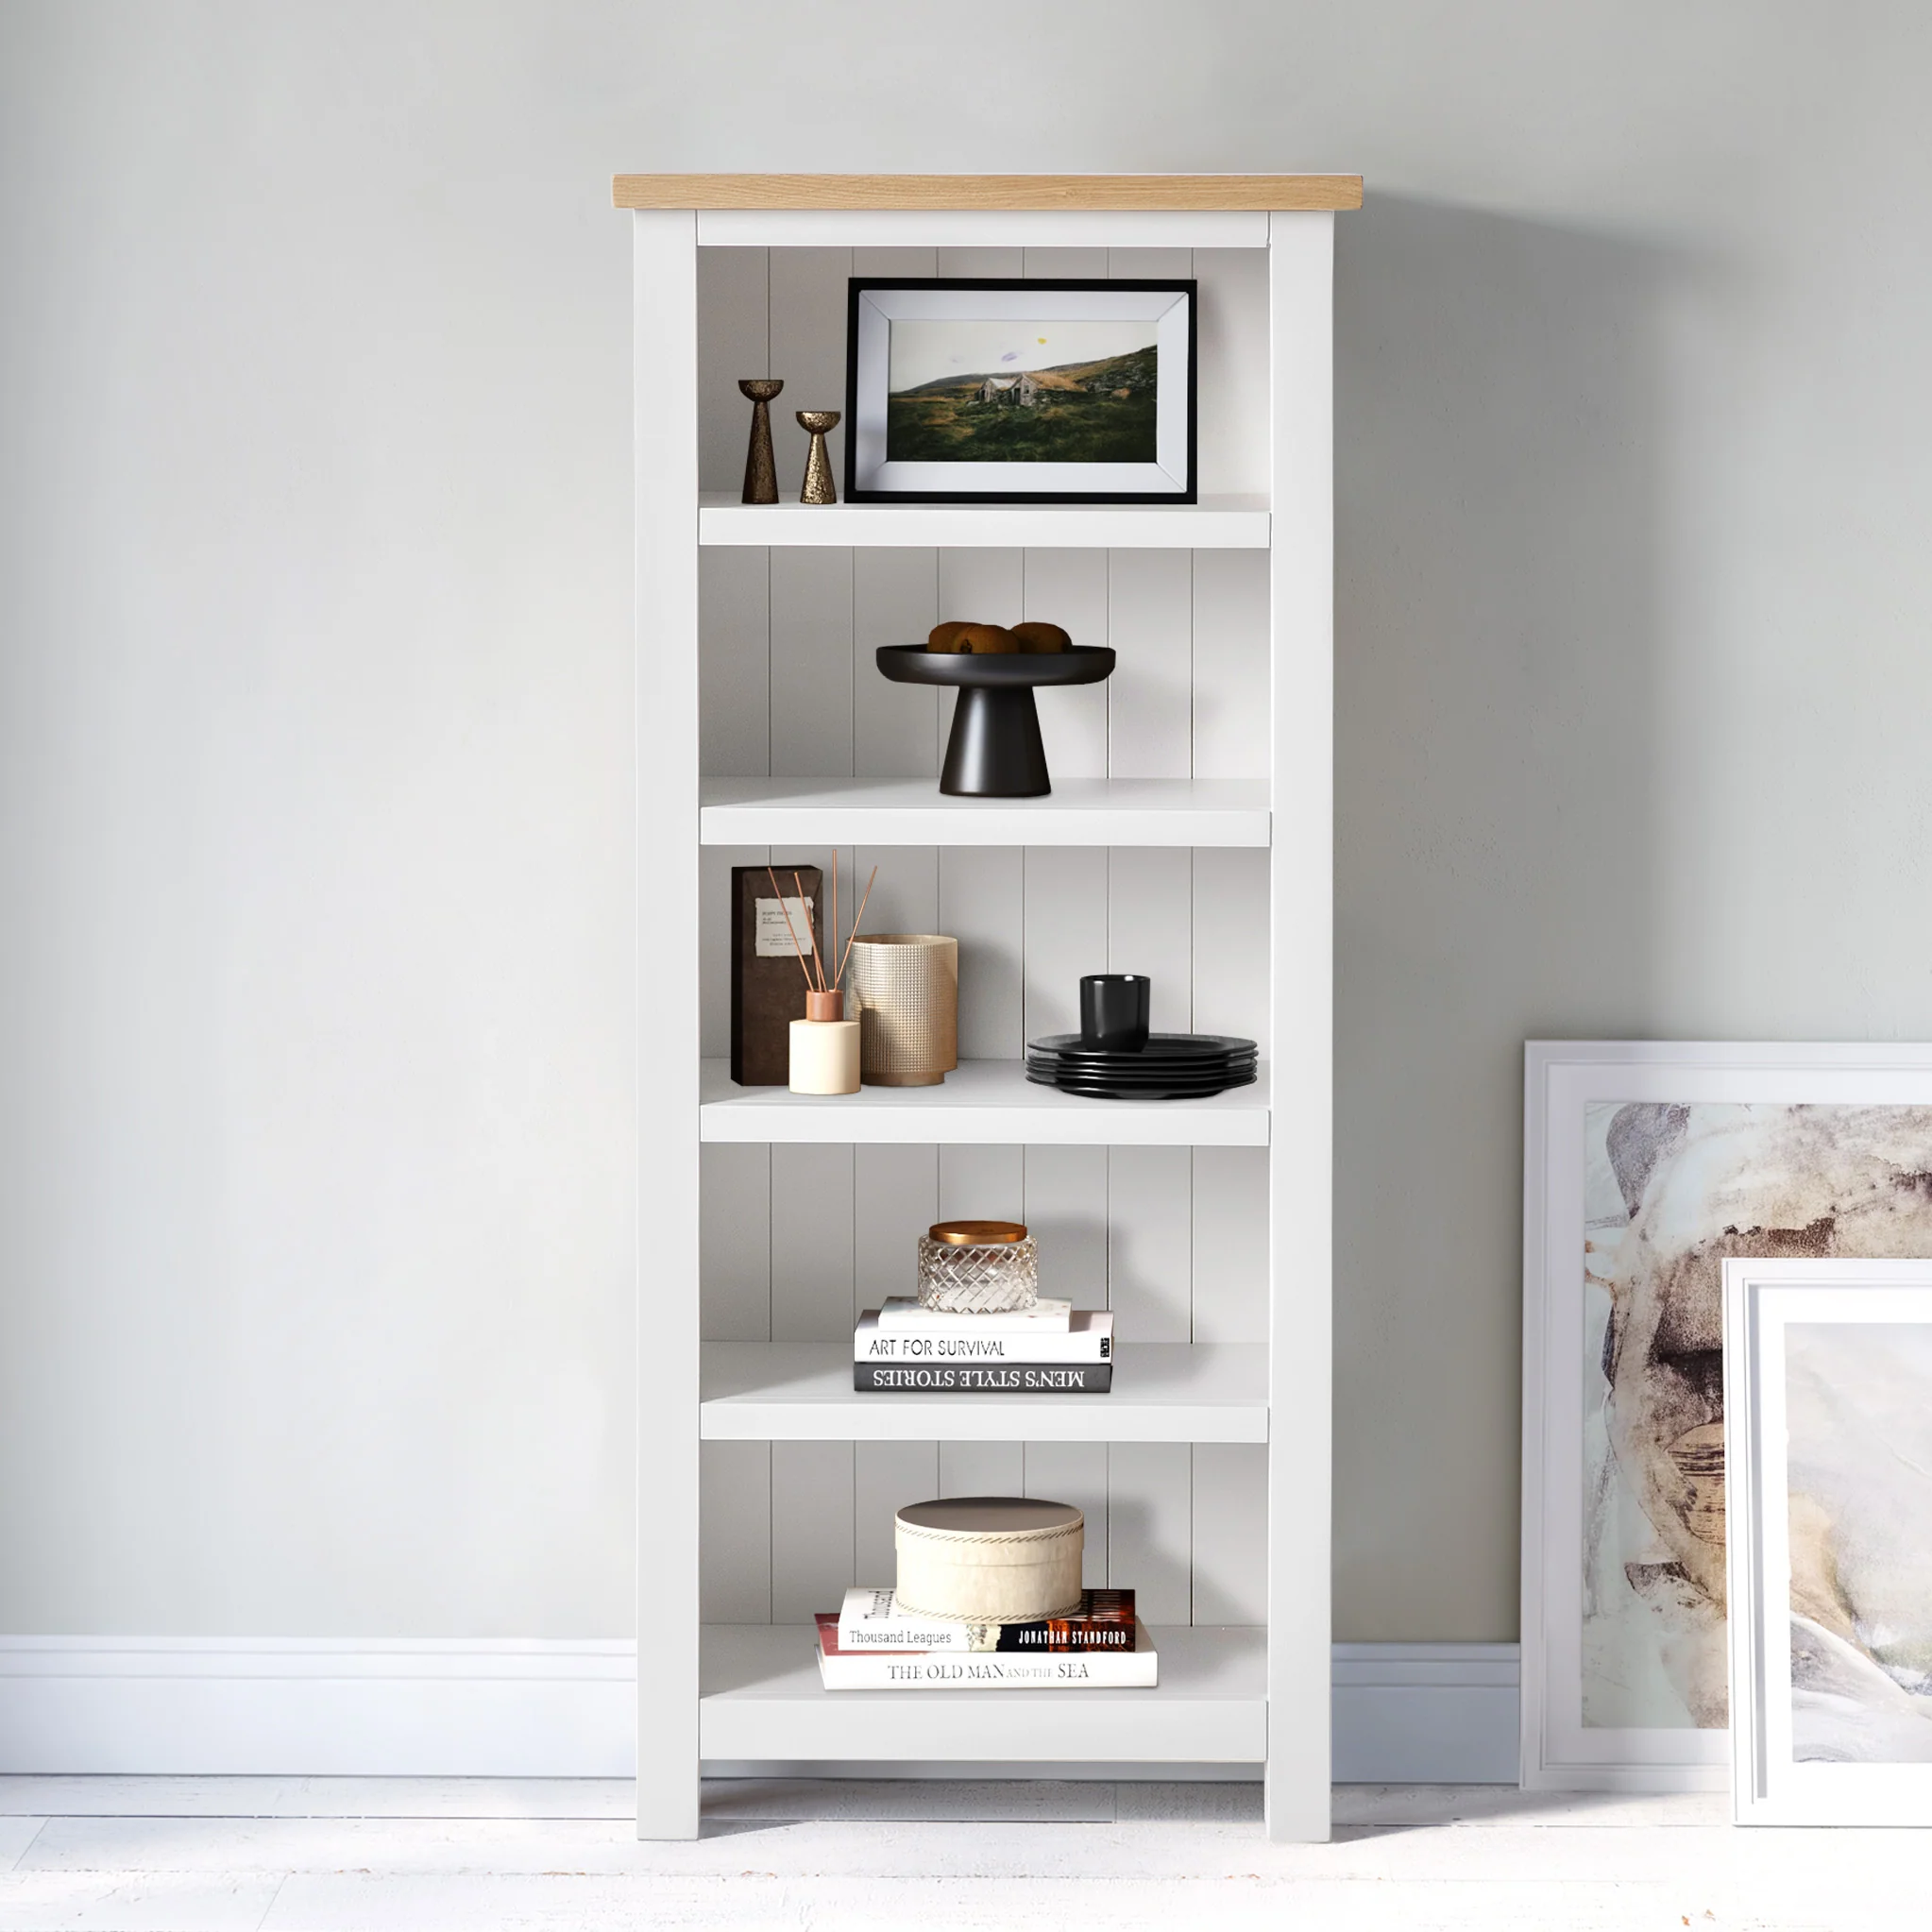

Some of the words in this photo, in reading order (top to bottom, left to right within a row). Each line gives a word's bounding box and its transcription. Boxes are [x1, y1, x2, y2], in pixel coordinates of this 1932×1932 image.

[869, 1339, 897, 1356] ART
[903, 1339, 933, 1356] FOR
[938, 1340, 1006, 1356] SURVIVAL
[873, 1369, 956, 1387] STORIES
[958, 1369, 1021, 1387] STYLE
[1025, 1370, 1085, 1387] MEN'S
[849, 1629, 905, 1643] Thousand
[907, 1630, 952, 1646] Leagues
[1019, 1630, 1068, 1644] JONATHAN
[1072, 1631, 1127, 1644] STANDFORD
[888, 1664, 924, 1680] THE
[926, 1664, 963, 1679] OLD
[967, 1663, 1005, 1679] MAN
[1006, 1668, 1030, 1678] AND
[1031, 1668, 1054, 1678] THE
[1058, 1663, 1090, 1678] SEA
